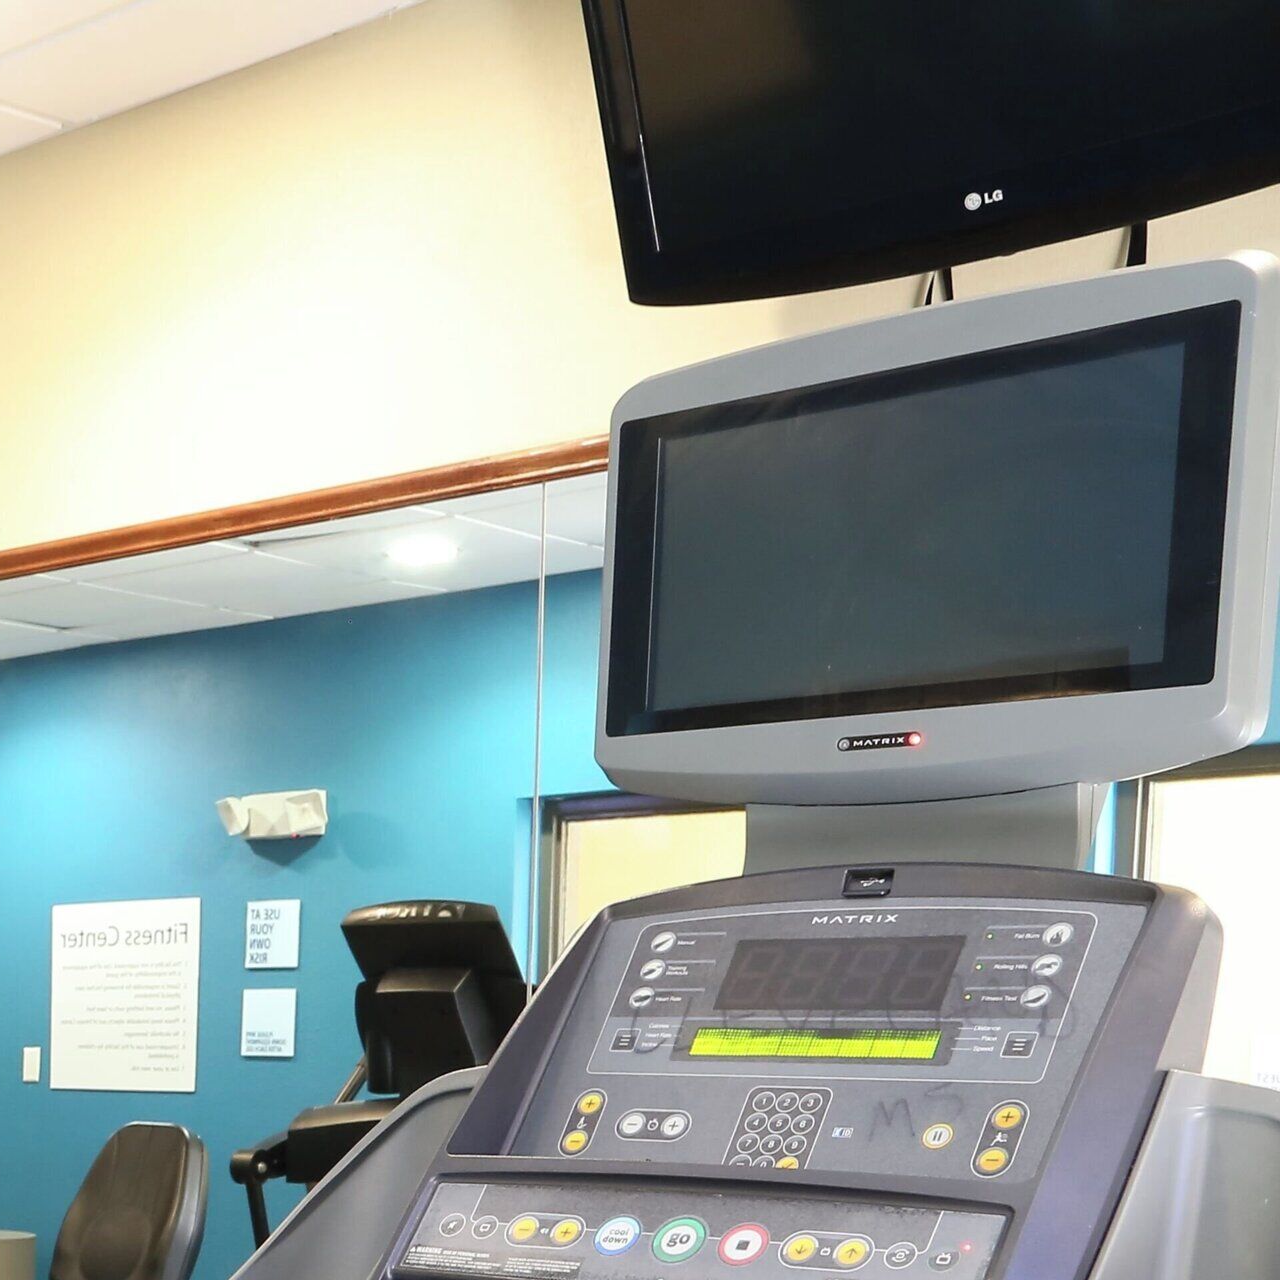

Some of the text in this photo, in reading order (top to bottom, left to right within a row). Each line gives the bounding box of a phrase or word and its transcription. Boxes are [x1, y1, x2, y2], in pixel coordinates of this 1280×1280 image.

[984, 189, 1003, 204] LG
[853, 737, 905, 747] MATRIX
[811, 914, 899, 925] MATRIX
[783, 1098, 791, 1107] 2
[806, 1099, 815, 1107] 3
[752, 1119, 807, 1129] 4 5 6
[745, 1139, 799, 1150] 7 8 9
[609, 1227, 630, 1236] cool
[602, 1235, 629, 1244] down
[666, 1232, 692, 1248] go
